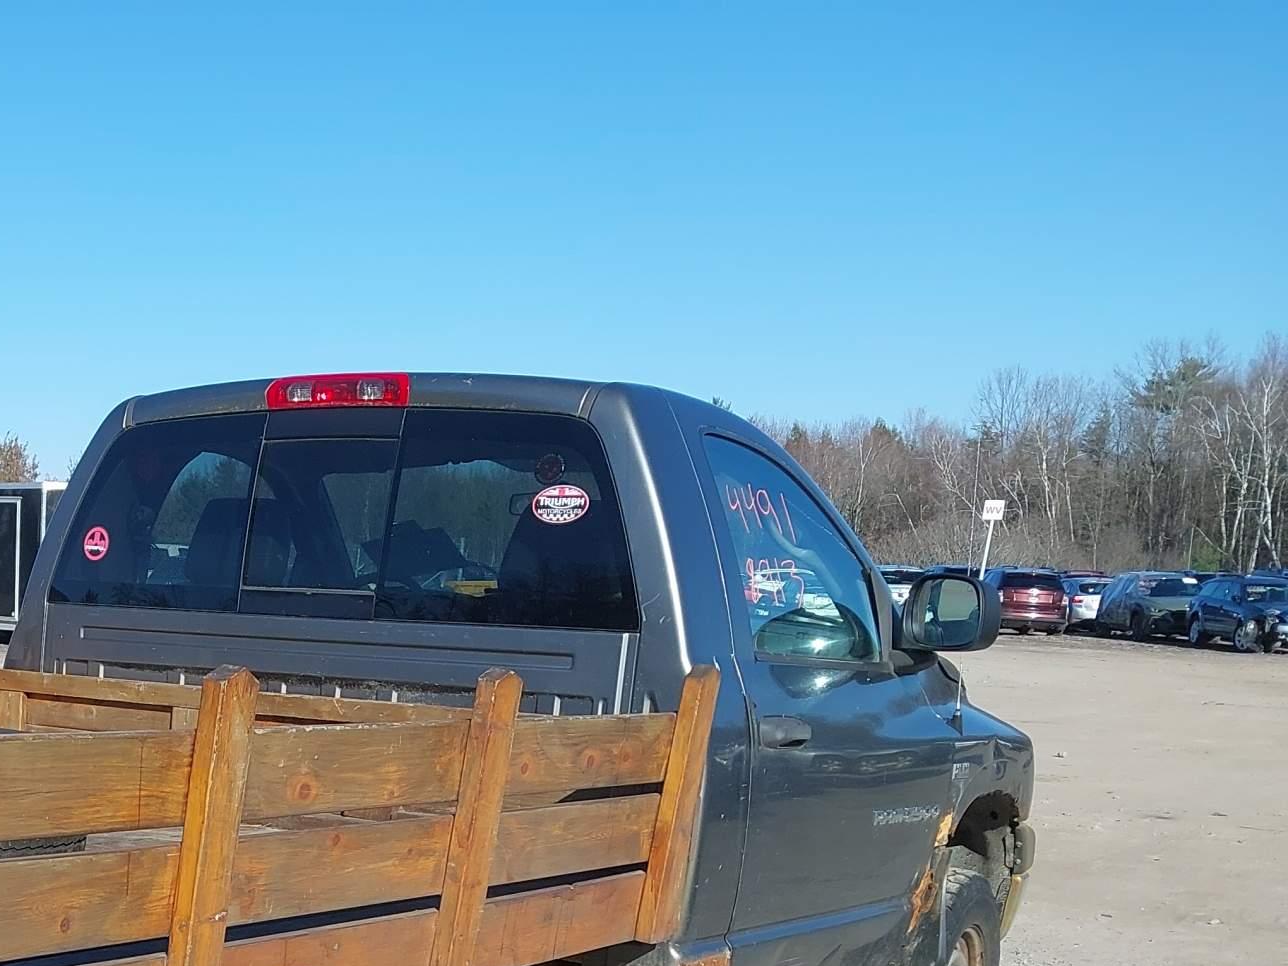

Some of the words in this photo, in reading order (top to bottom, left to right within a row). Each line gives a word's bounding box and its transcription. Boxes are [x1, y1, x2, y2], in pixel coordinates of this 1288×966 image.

[538, 496, 584, 508] TRIUMPH
[537, 507, 582, 515] MOTORCYCLES
[725, 482, 797, 544] 4491
